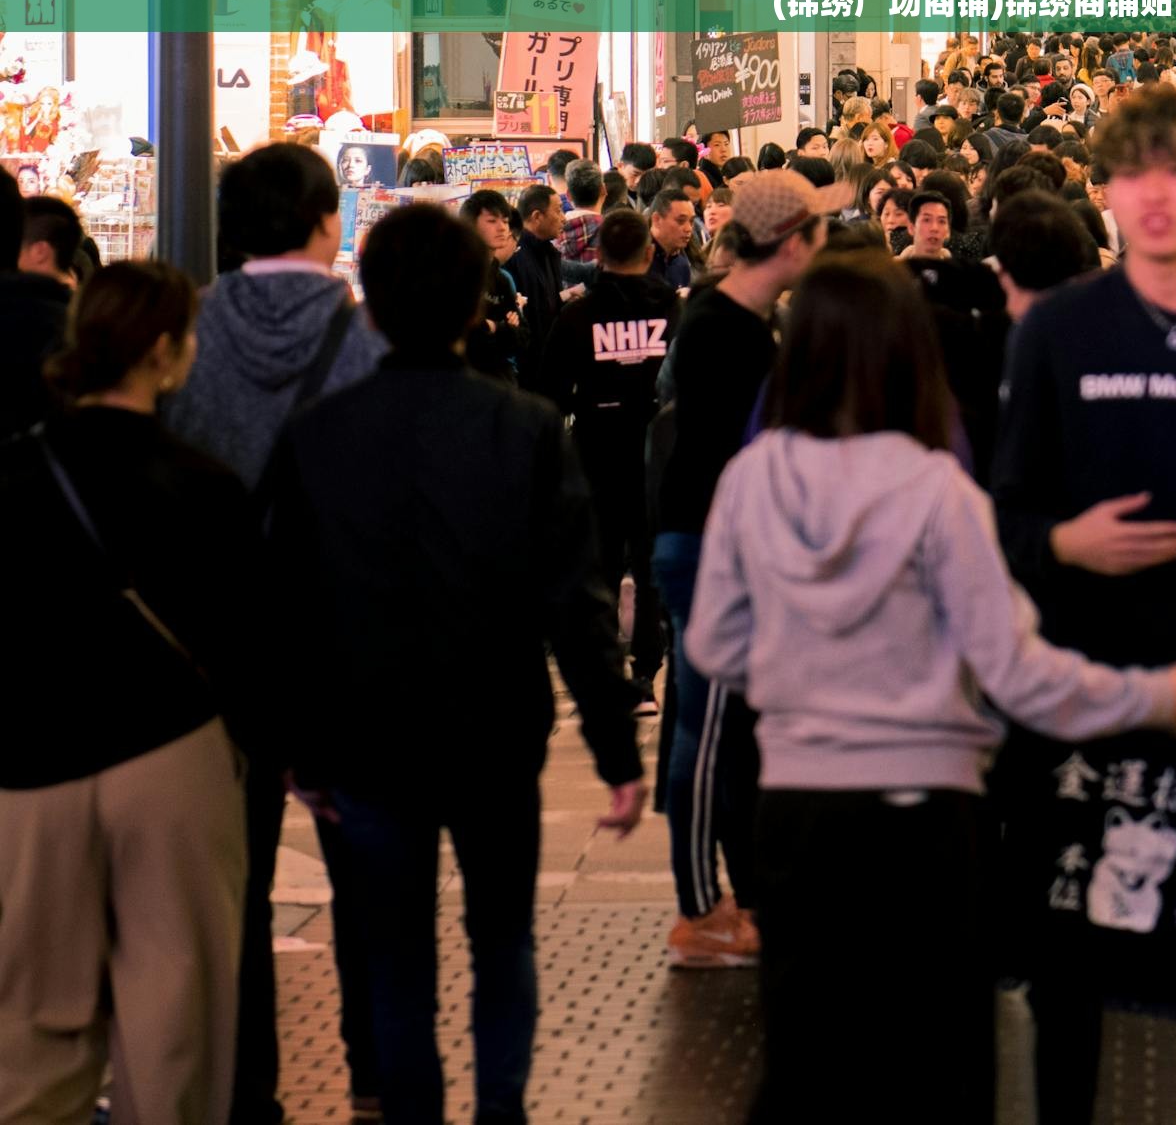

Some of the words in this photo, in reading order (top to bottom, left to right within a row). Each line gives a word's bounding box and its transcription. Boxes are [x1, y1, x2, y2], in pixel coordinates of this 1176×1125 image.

[734, 53, 781, 93] ¥900
[592, 318, 668, 352] NHIZ
[1080, 373, 1146, 400] BMW
